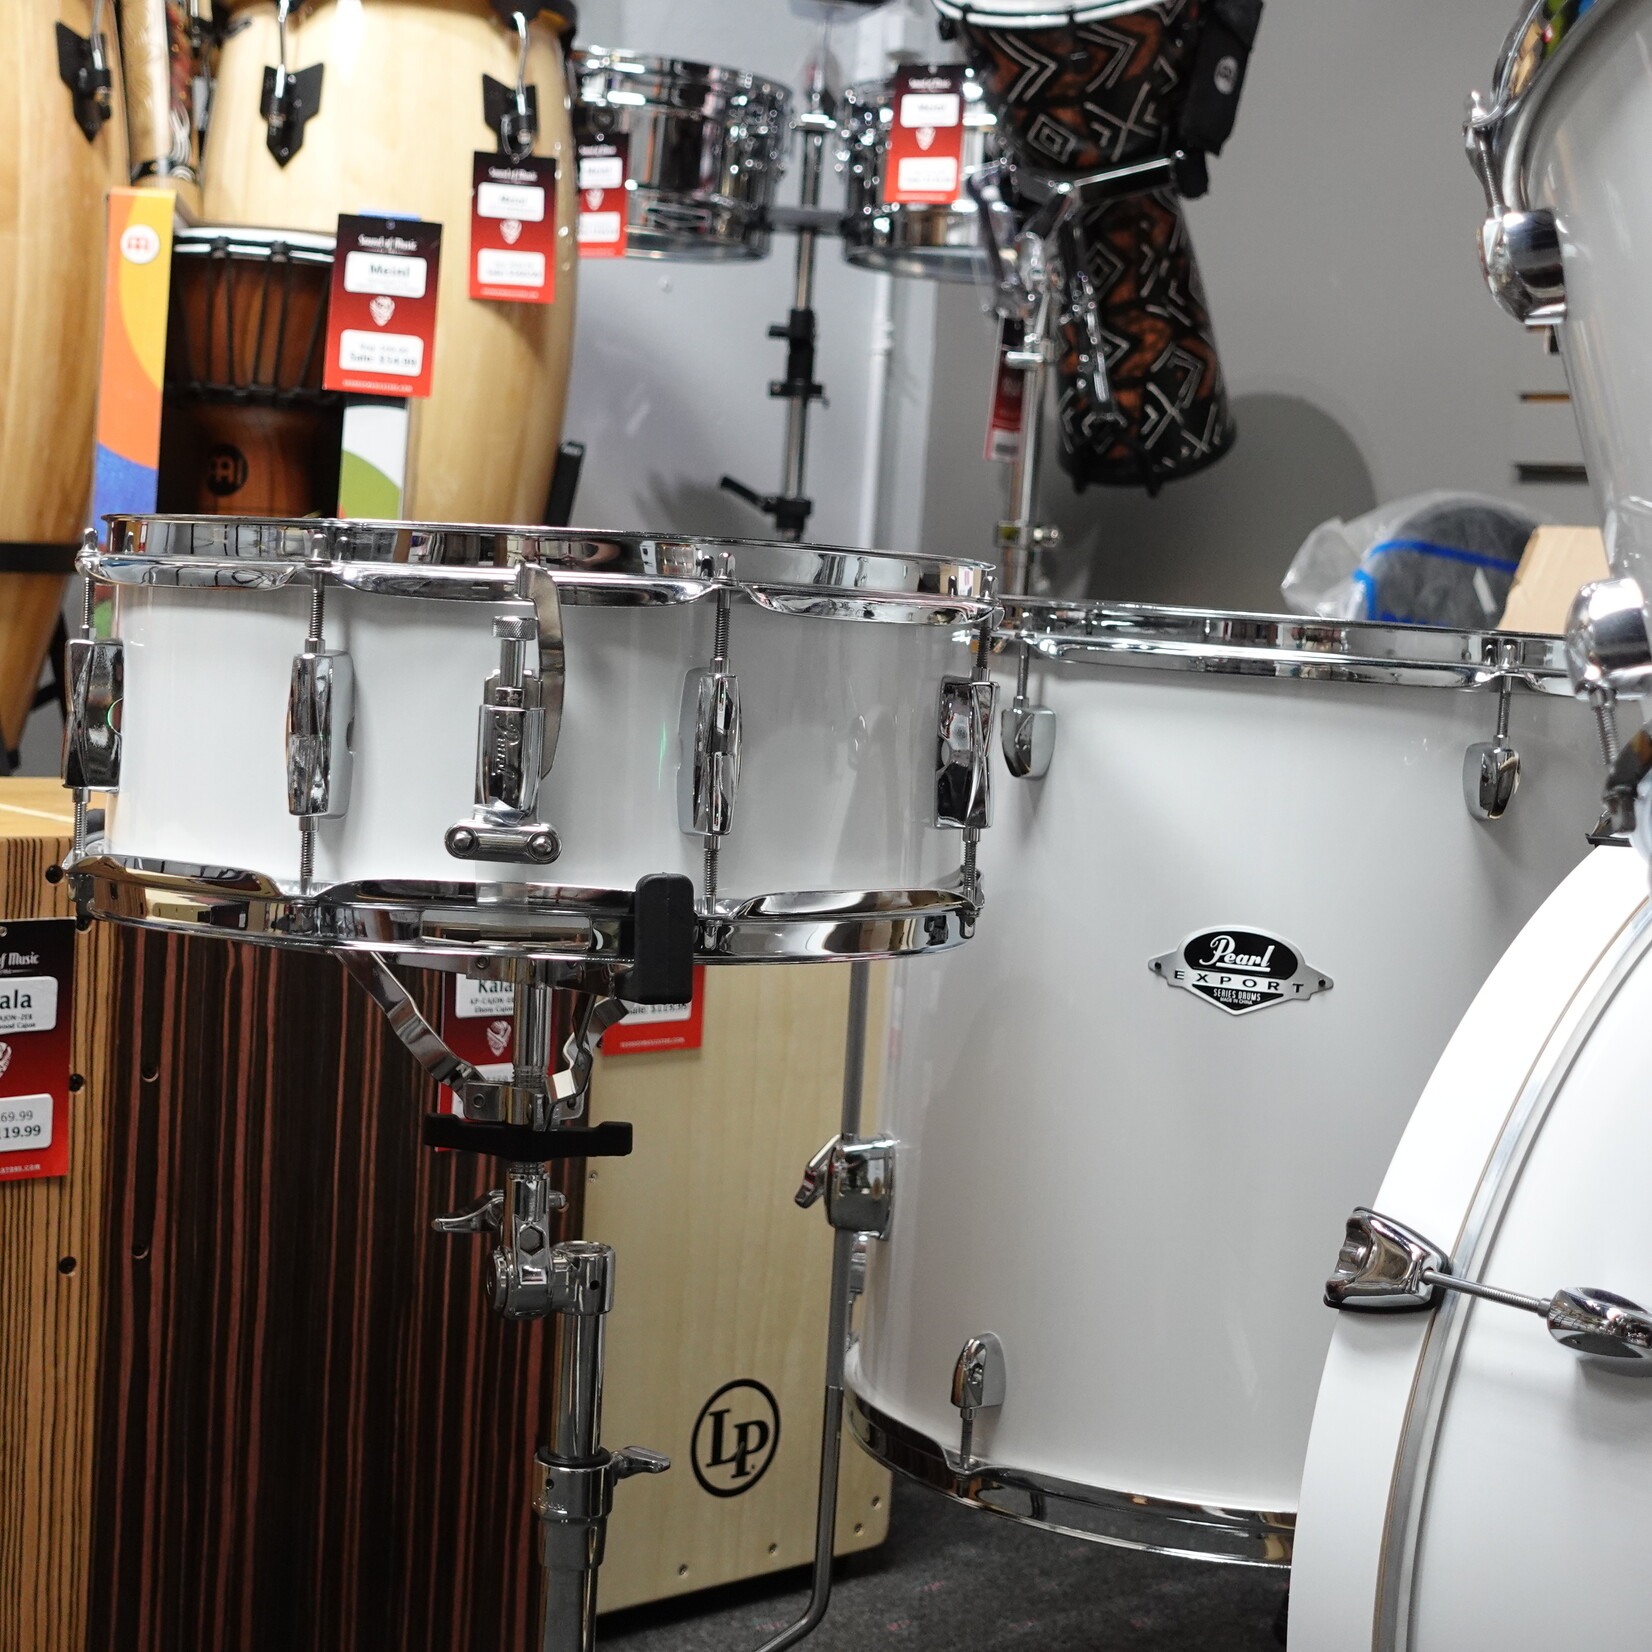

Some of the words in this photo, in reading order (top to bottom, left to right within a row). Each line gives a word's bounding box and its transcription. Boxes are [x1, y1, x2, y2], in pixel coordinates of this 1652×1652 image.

[8, 951, 40, 966] Music
[1199, 935, 1275, 967] Pearl
[478, 979, 513, 994] Kala
[1174, 970, 1304, 994] EXPORT
[1213, 988, 1237, 999] SERIES
[1238, 991, 1261, 1002] DRUMS
[0, 1124, 42, 1140] 19.99
